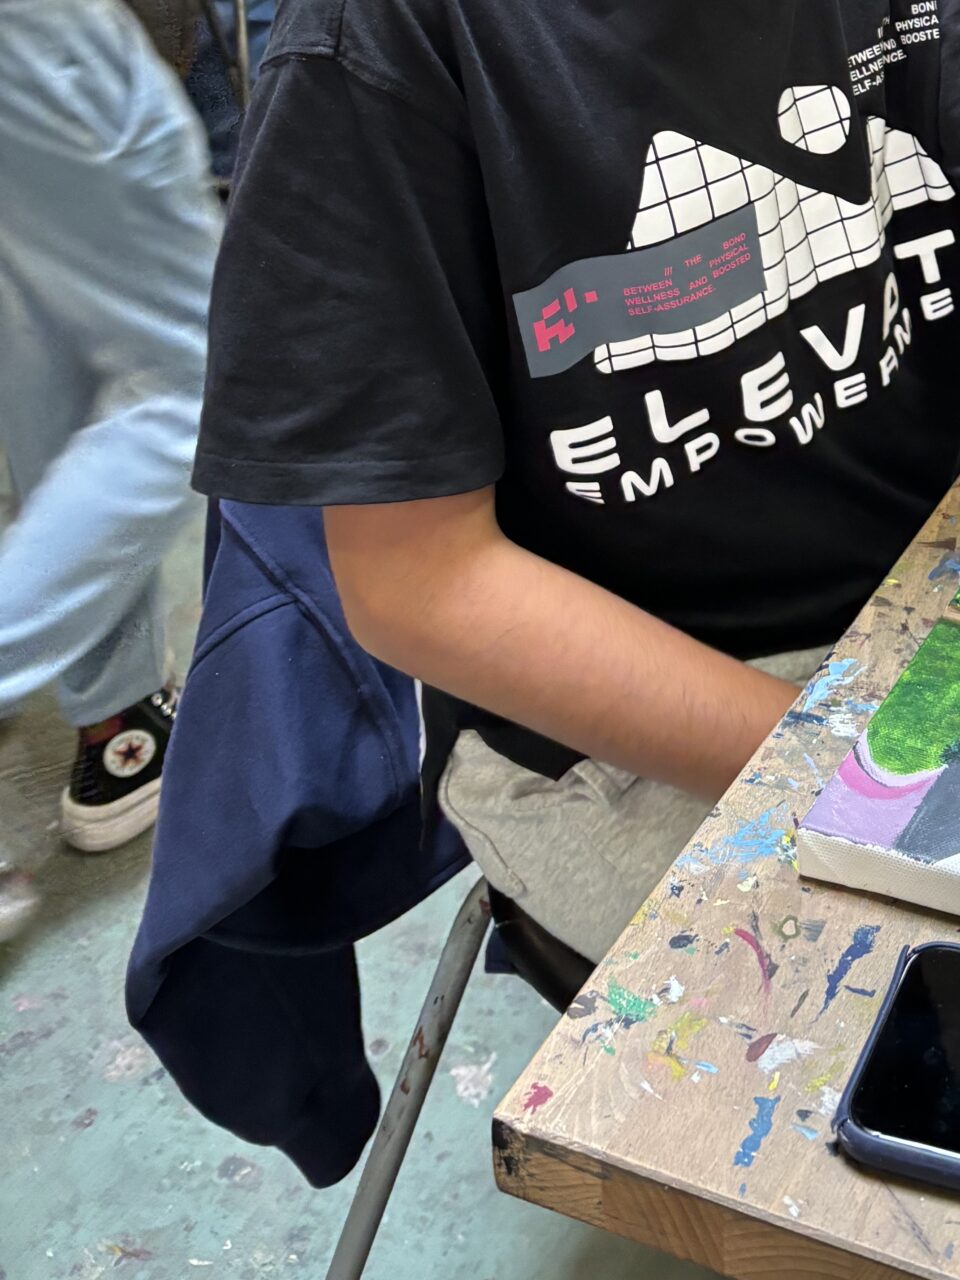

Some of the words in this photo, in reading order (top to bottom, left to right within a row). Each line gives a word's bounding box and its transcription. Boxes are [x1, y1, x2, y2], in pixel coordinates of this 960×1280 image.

[623, 279, 673, 297] BETWEEN
[708, 244, 749, 268] PHYSICAL
[683, 254, 702, 268] THE
[722, 232, 746, 250] BOND
[624, 287, 680, 306] WELLNESS
[688, 275, 708, 291] AND
[711, 252, 751, 279] BOOSTED
